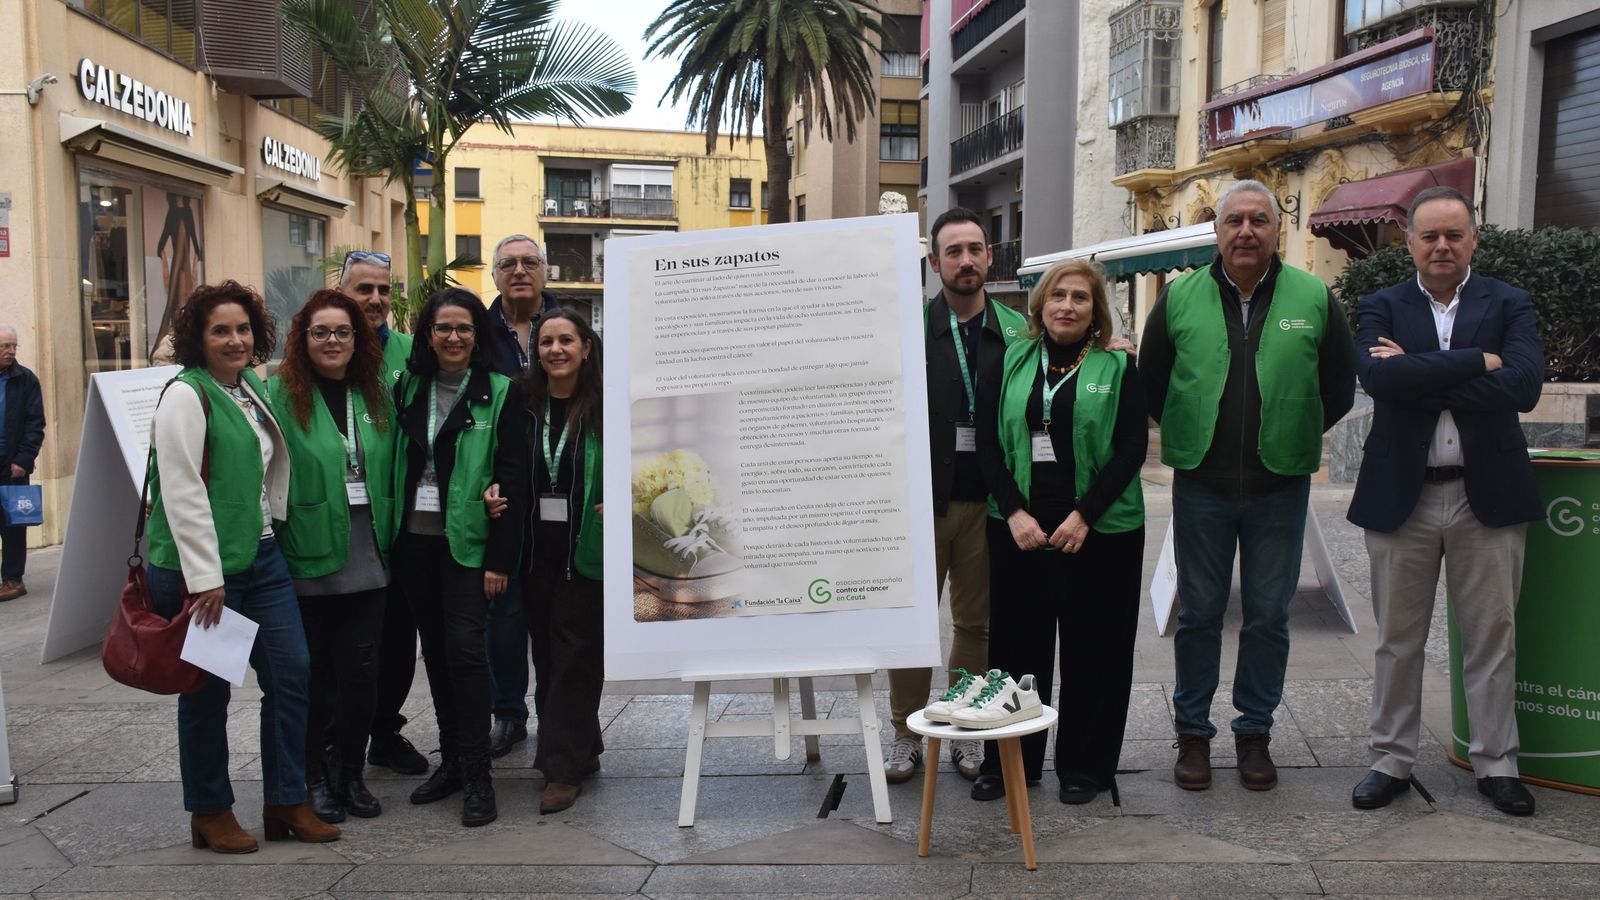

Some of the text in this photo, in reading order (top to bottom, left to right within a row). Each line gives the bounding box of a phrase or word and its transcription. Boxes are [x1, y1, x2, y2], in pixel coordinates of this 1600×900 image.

[1381, 77, 1405, 92] AGENCIA
[80, 58, 193, 137] CALZEDONIA
[263, 136, 321, 181] CALZEDONIA
[655, 250, 780, 271] En sus zapatos
[826, 381, 863, 391] experiencias
[878, 378, 893, 388] parte
[770, 396, 790, 405] equipo
[848, 390, 866, 399] grupo
[739, 404, 782, 415] comprometido
[782, 402, 808, 411] formado
[870, 398, 888, 406] apoyo
[739, 413, 791, 424] acompañamiento
[796, 411, 824, 421] pacientes
[856, 405, 895, 416] participación
[748, 424, 771, 433] órganos
[809, 417, 846, 427] voluntariado
[739, 432, 769, 441] obtención
[809, 428, 833, 436] muchas
[739, 443, 763, 451] entrega
[794, 457, 822, 466] personas
[823, 455, 843, 464] aporta
[839, 461, 876, 470] convirtiendo
[741, 479, 757, 488] gesto
[779, 474, 816, 485] oportunidad
[867, 470, 891, 479] quienes
[750, 504, 787, 513] voluntariado
[824, 500, 837, 510] deja
[804, 519, 833, 530] profundo
[743, 543, 765, 552] Porque
[842, 535, 881, 544] voluntariado
[882, 535, 892, 543] hay
[743, 552, 766, 560] mirada
[743, 561, 770, 569] voluntad
[783, 559, 818, 567] transforma
[872, 577, 902, 585] española
[1515, 680, 1544, 695] ntra
[1548, 684, 1563, 697] el
[1515, 700, 1544, 713] mos
[1548, 704, 1581, 718] solo
